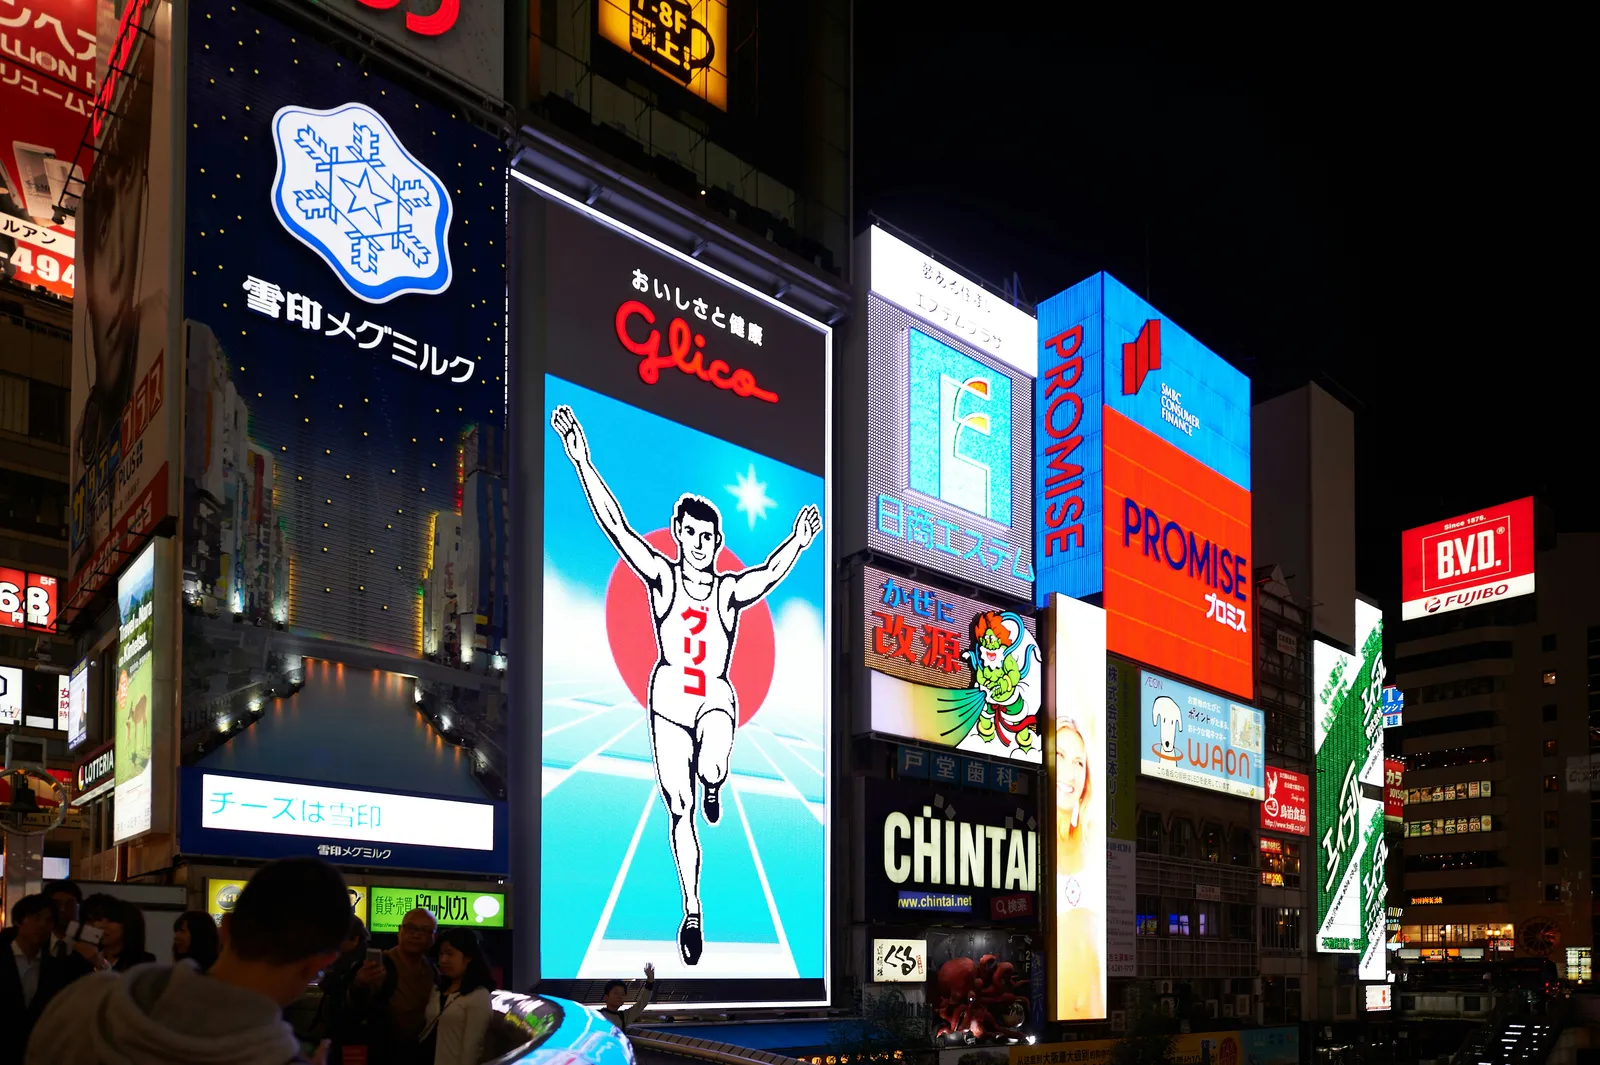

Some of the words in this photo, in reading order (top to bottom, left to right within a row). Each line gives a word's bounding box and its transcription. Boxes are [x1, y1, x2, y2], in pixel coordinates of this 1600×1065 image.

[242, 275, 475, 383] 雪印メグミルク
[632, 269, 763, 347] おいしさと健康
[616, 300, 779, 403] Glico
[1161, 382, 1182, 405] SMBC
[1161, 395, 1201, 430] CONSUMER
[1044, 324, 1084, 558] PROMISE
[1161, 407, 1193, 437] FINANCE
[877, 493, 1036, 583] 日商エステム
[1123, 497, 1247, 601] PROMISE
[1437, 529, 1502, 580] B.V.D.
[882, 578, 955, 624] かぜに
[1205, 593, 1247, 633] プロミス
[1445, 584, 1509, 608] FUJIBO
[681, 605, 709, 698] グリコ
[873, 610, 962, 674] 改源
[84, 749, 114, 784] LOTTERIA
[1187, 737, 1251, 780] WAON
[209, 791, 382, 829] チーズは雪印
[1322, 760, 1363, 893] エイブル
[317, 844, 391, 859] 雪印メグミルク
[884, 805, 1037, 892] CHINTAI
